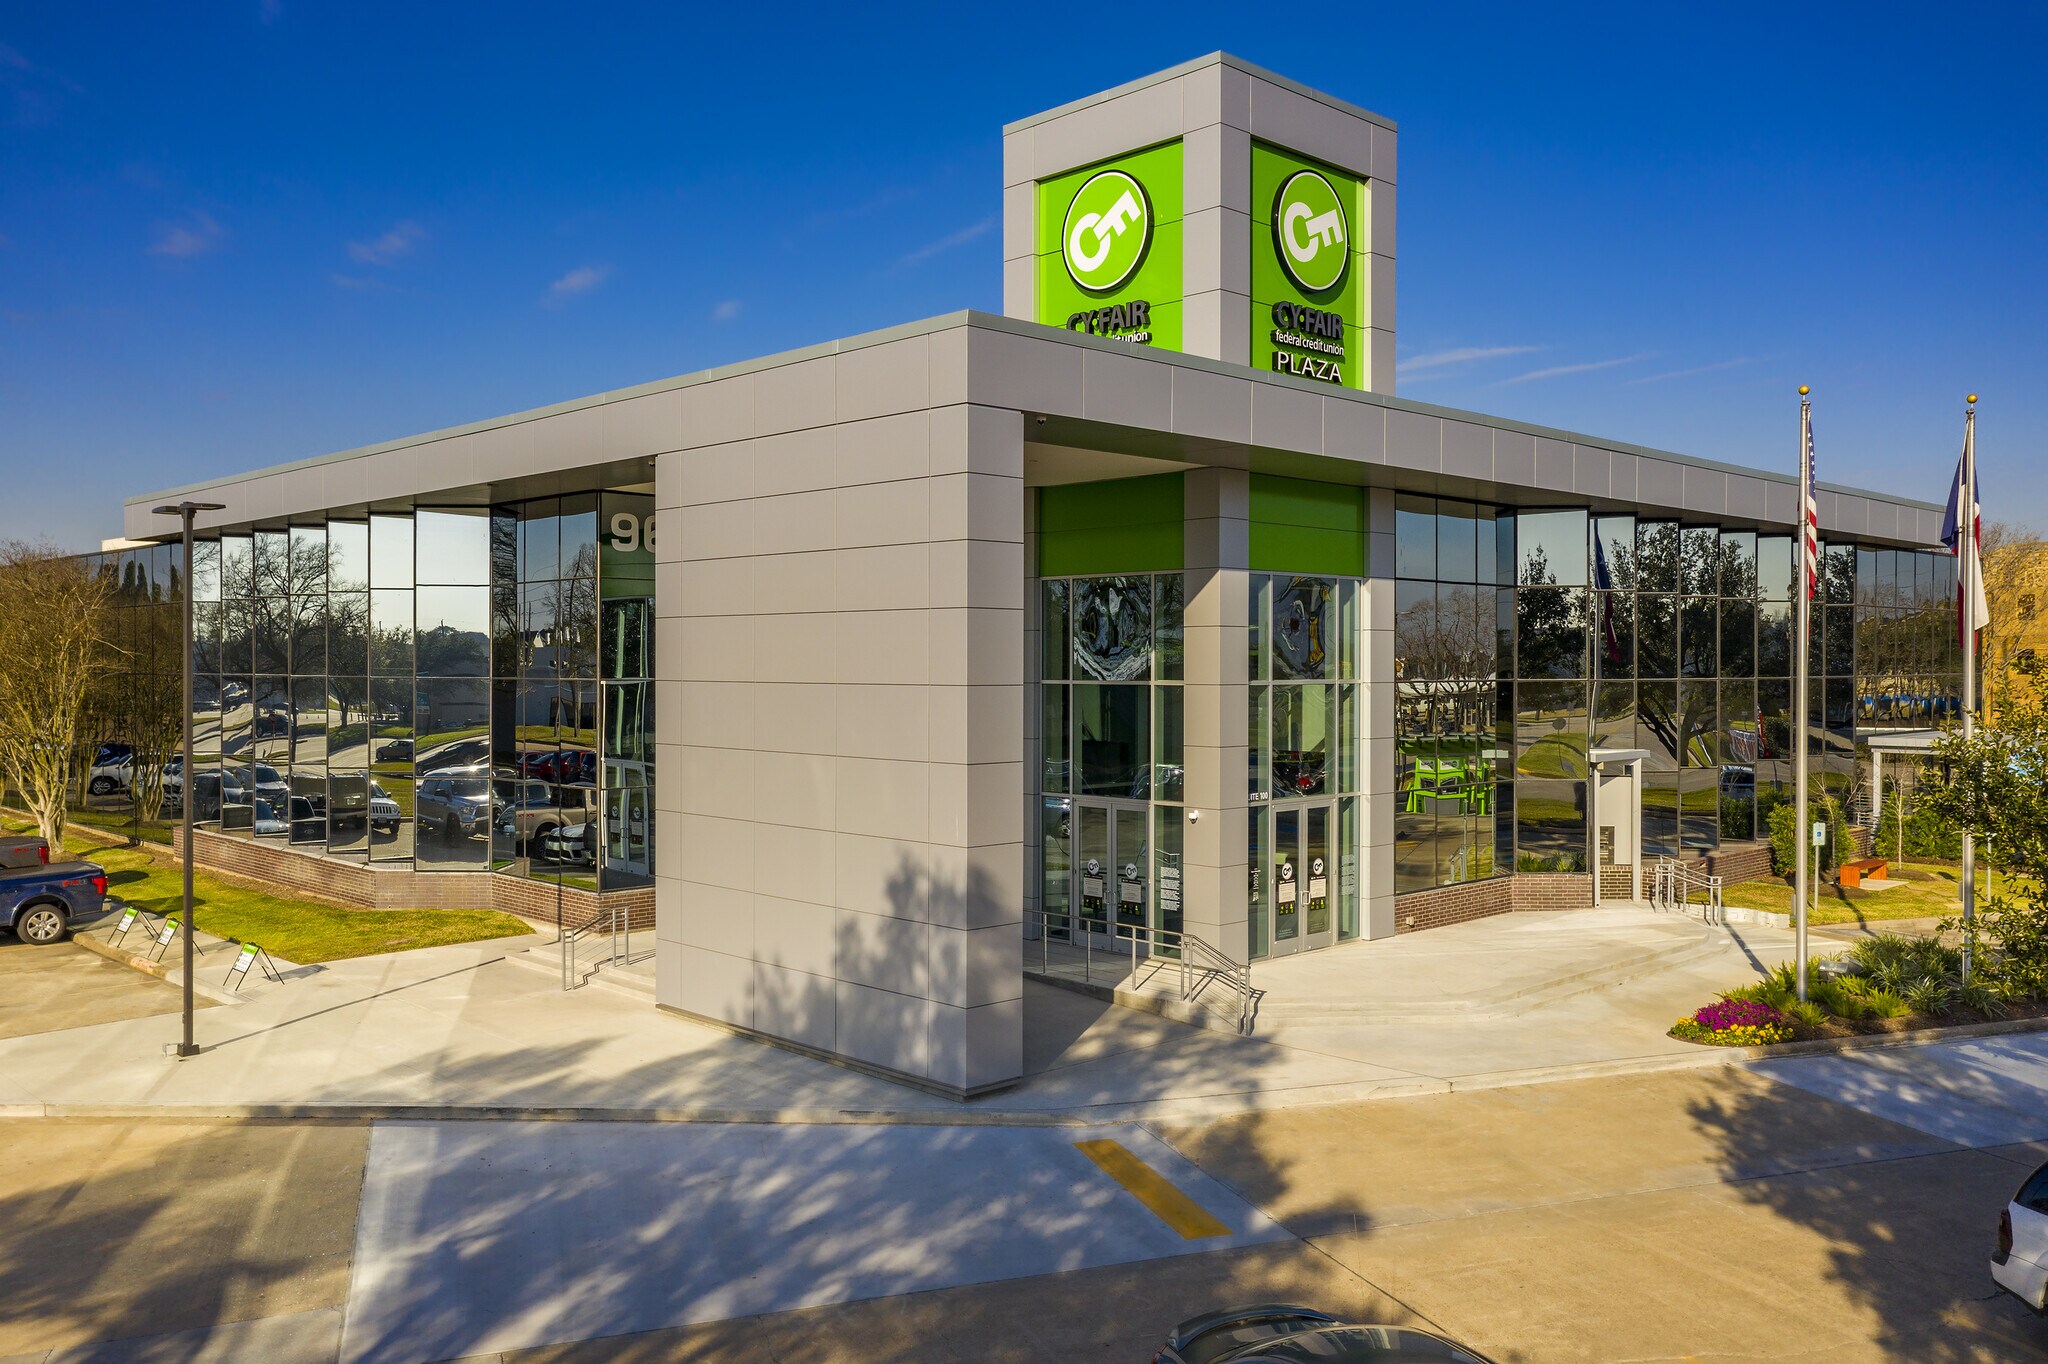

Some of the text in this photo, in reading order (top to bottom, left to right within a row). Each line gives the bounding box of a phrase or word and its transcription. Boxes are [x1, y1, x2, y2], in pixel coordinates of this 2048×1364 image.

[1275, 329, 1345, 356] federal credit union
[1277, 351, 1342, 383] PLAZA
